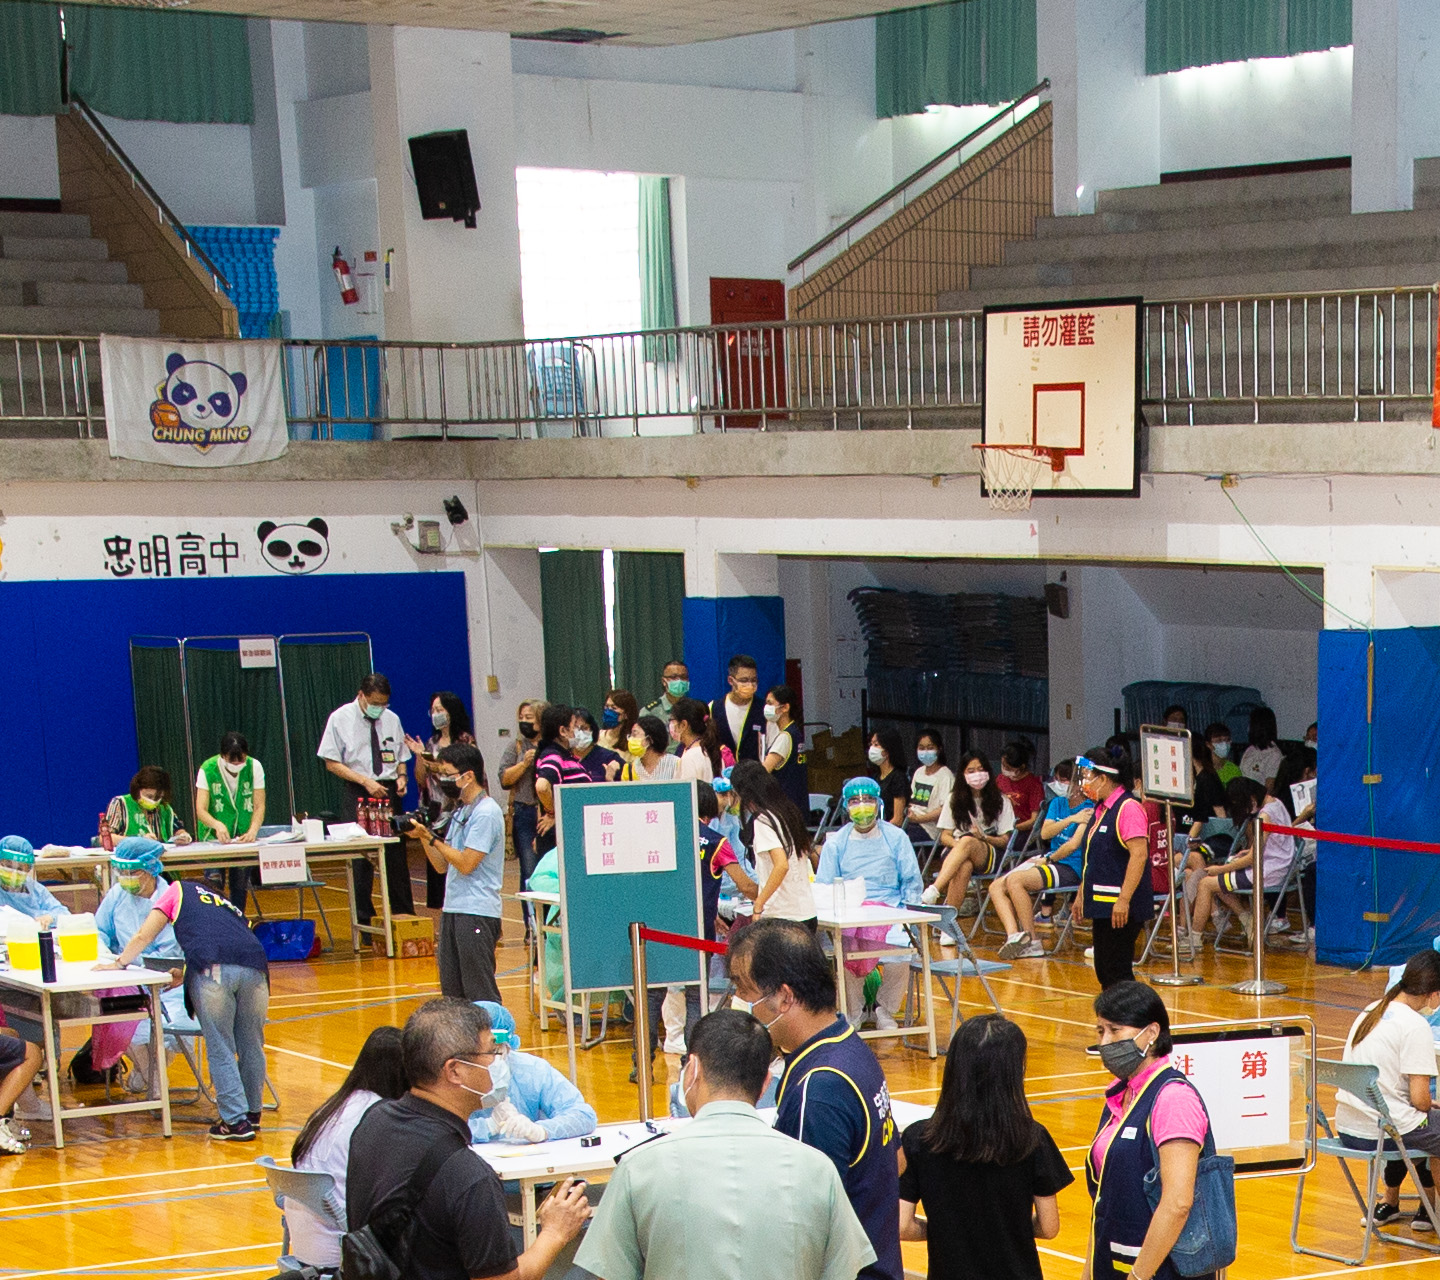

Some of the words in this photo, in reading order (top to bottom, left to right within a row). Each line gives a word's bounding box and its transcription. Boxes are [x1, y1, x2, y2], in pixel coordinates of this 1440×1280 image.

[1023, 312, 1095, 348] 請勿灌籃
[153, 426, 206, 443] CHUNG
[209, 425, 251, 442] MING
[103, 532, 240, 577] 忠明高中
[600, 811, 616, 867] 施打區
[645, 809, 660, 865] 疫苗
[1241, 1050, 1268, 1118] 第二
